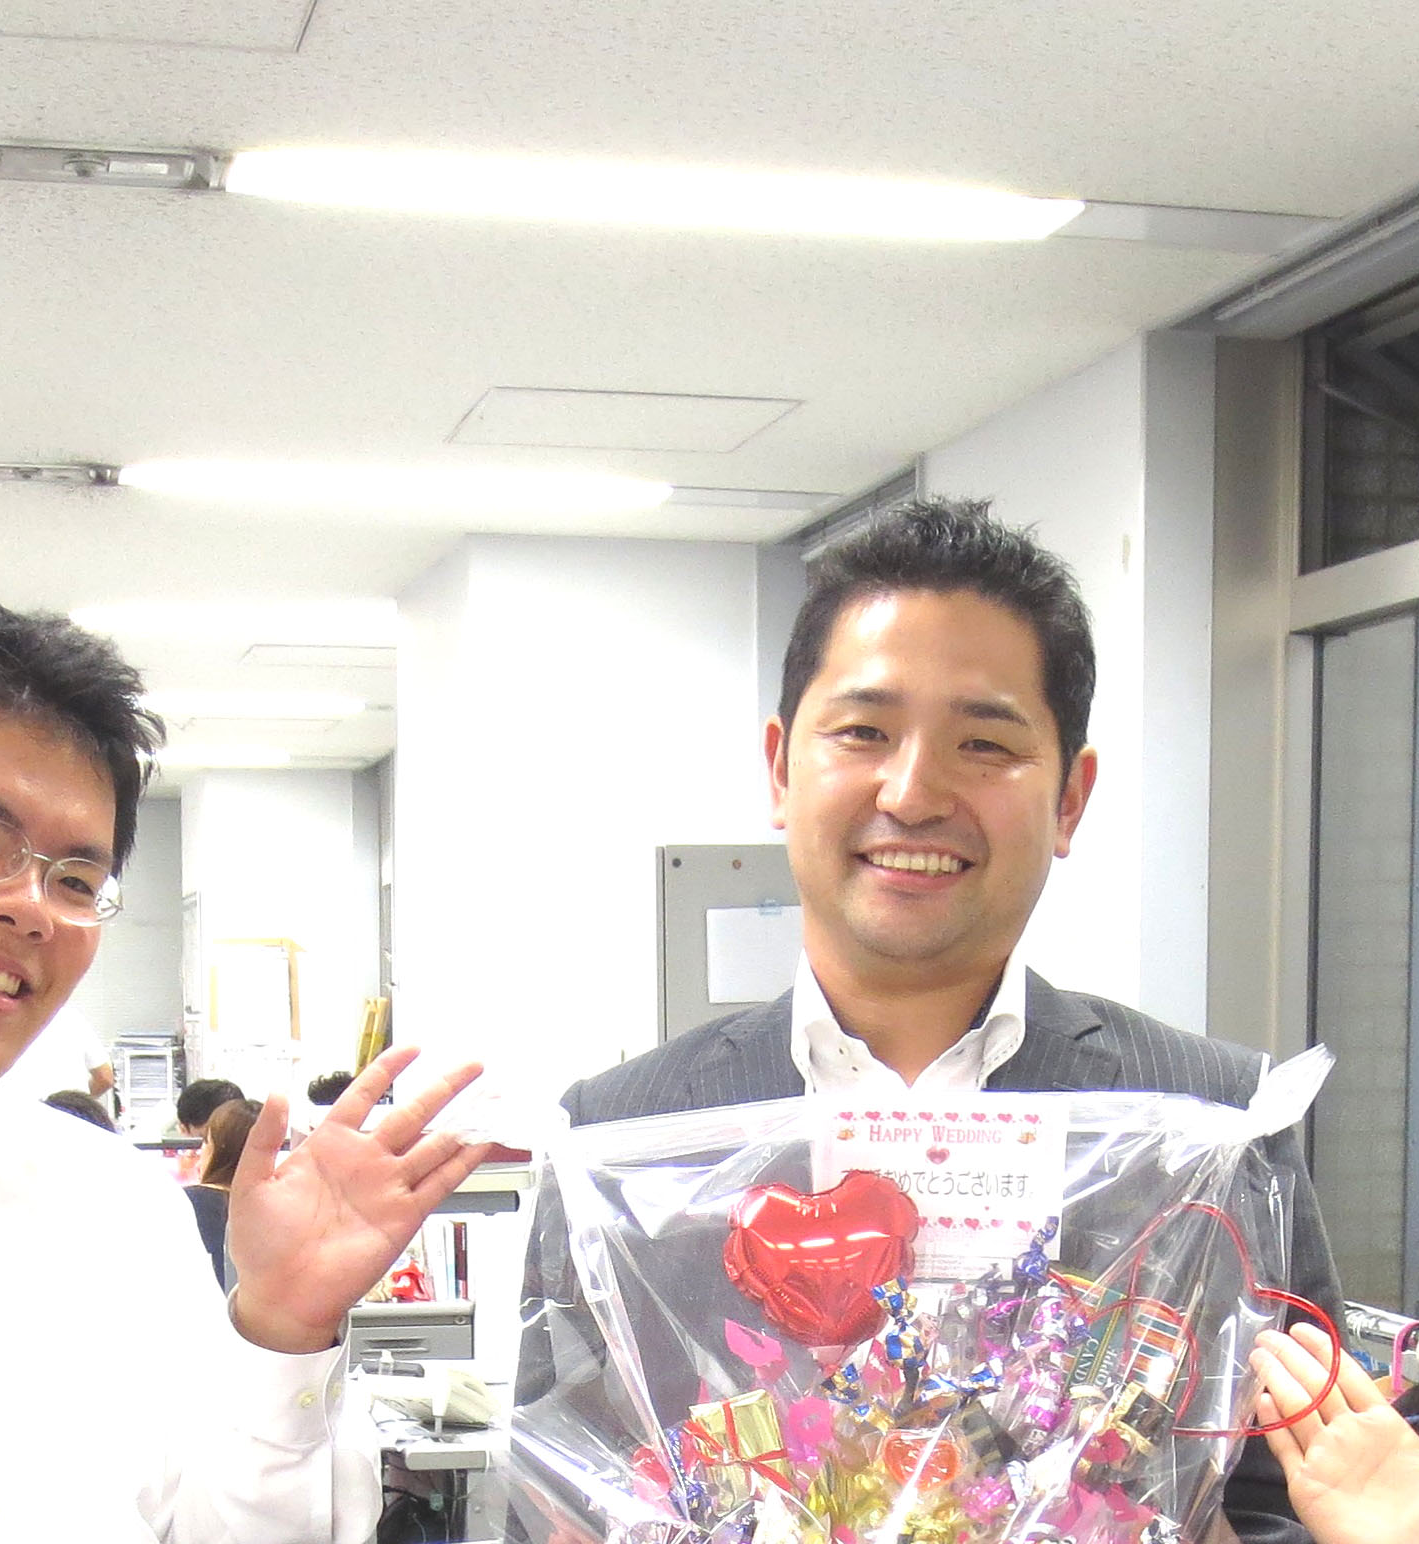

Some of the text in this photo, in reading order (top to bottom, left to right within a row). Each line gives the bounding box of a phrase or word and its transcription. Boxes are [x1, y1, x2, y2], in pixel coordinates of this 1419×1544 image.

[869, 1125, 1002, 1144] HAPPY WEDDING
[1074, 1337, 1100, 1381] CAND
